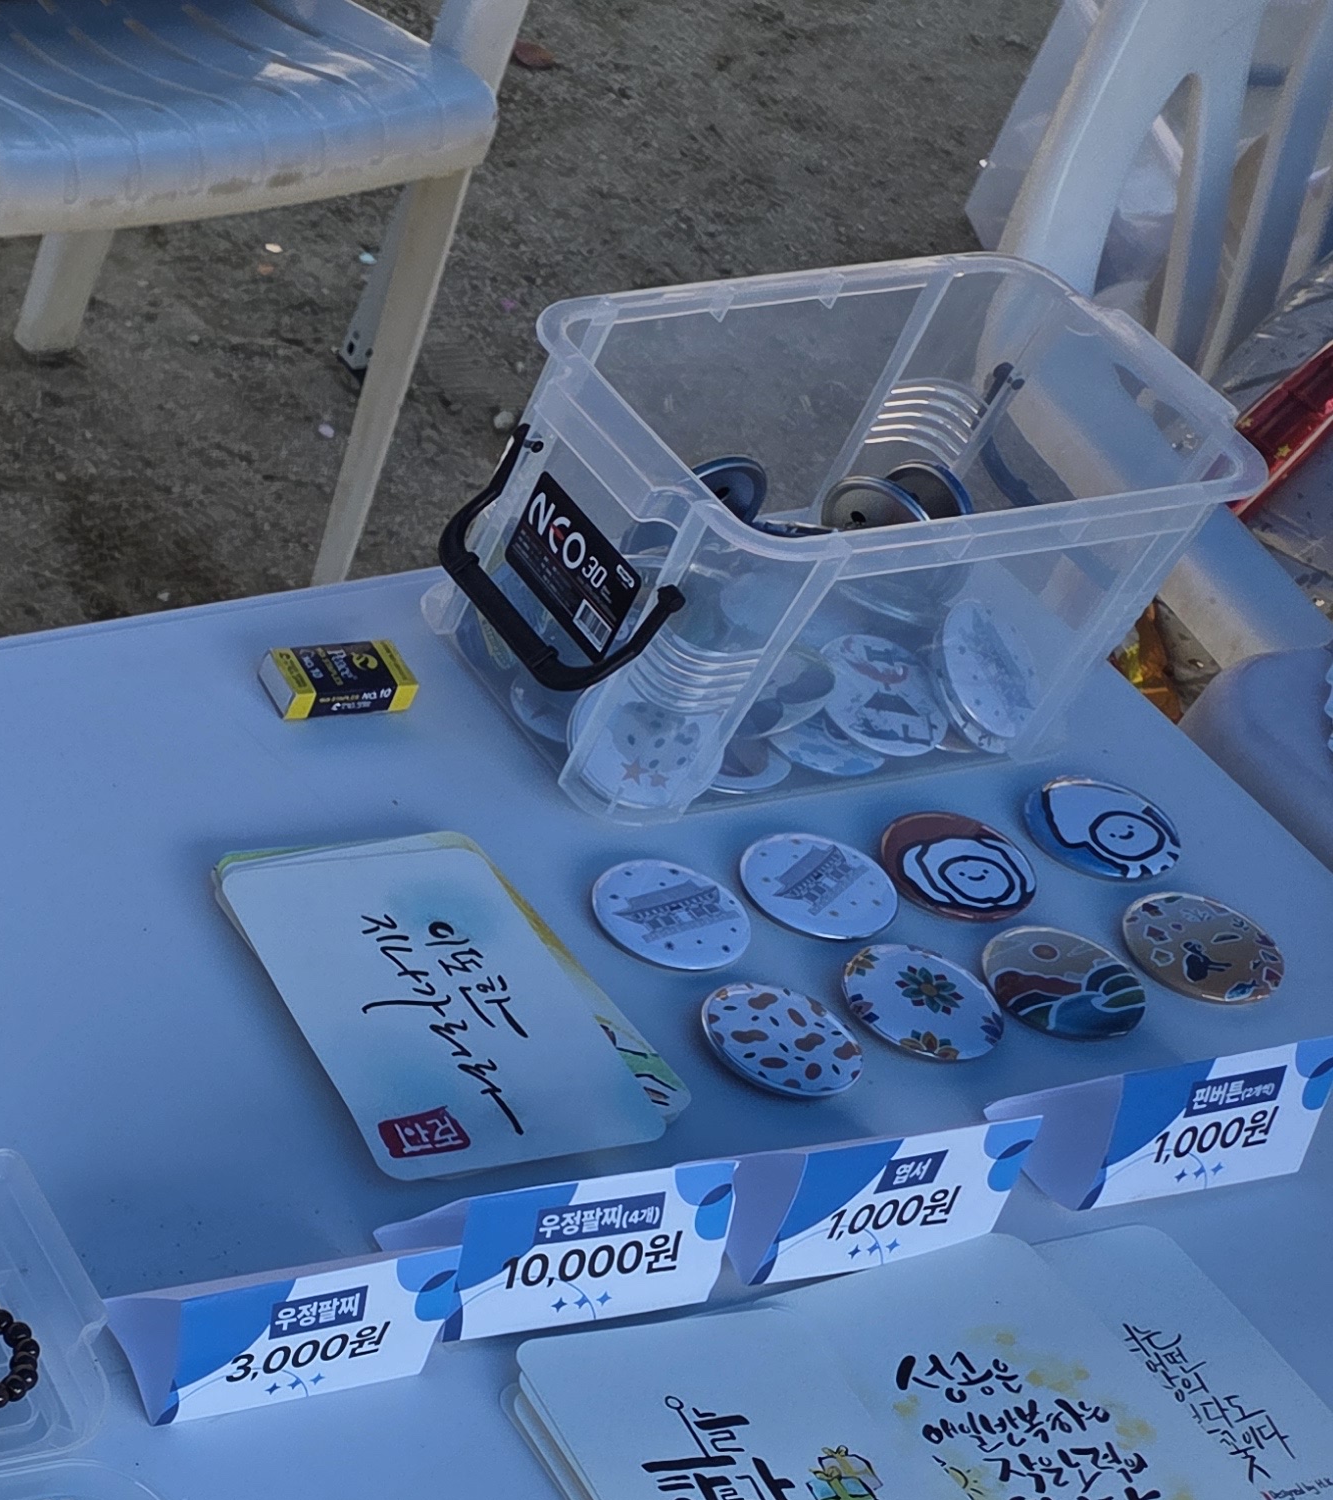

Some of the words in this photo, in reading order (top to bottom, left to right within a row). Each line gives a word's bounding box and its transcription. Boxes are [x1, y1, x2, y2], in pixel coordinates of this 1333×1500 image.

[528, 492, 586, 569] NEO
[1153, 1105, 1280, 1164] 1,000원
[892, 1157, 931, 1185] 엽서
[538, 1204, 660, 1239] 우정팔찌(4개)
[826, 1185, 962, 1241] 1,000원
[502, 1230, 683, 1289] 10,000원
[274, 1292, 361, 1331] 우정팔찌
[225, 1320, 391, 1383] 3,000원
[895, 1351, 1023, 1403] 성공은
[642, 1395, 750, 1473] 오늘
